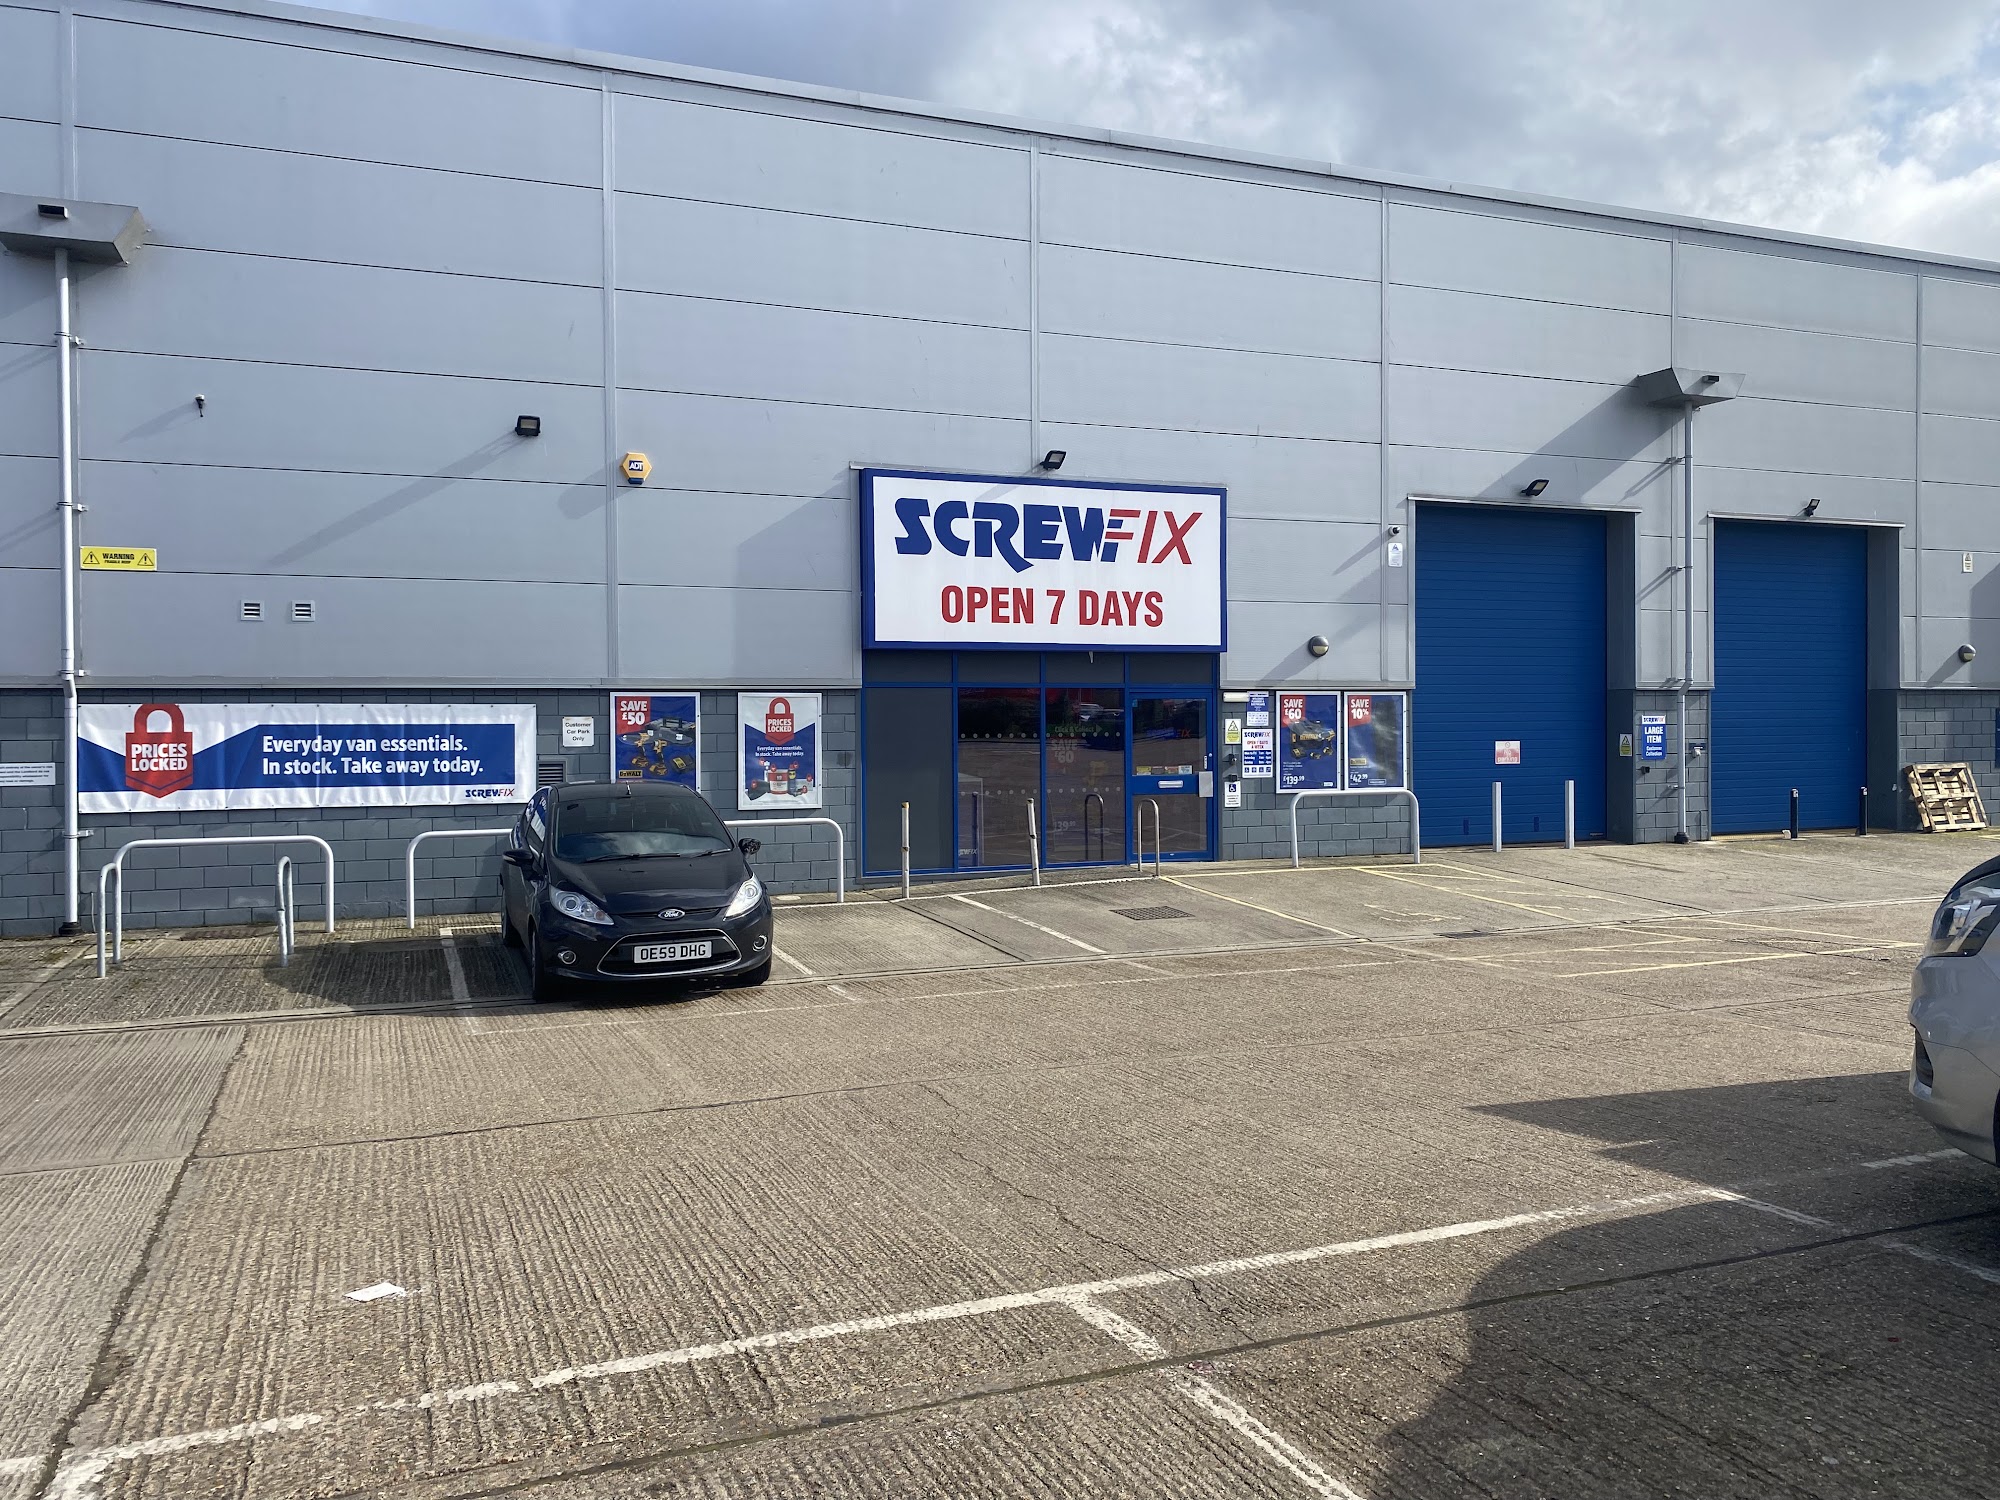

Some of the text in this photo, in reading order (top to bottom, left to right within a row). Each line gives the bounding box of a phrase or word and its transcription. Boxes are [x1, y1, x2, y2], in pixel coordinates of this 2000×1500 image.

[629, 461, 644, 471] ADT
[894, 497, 1203, 573] SCREWFIX
[941, 585, 1164, 627] OPEN 7 DAYS
[620, 700, 648, 711] SAVE
[1283, 698, 1304, 708] SAVE
[1350, 698, 1370, 708] SAVE
[622, 711, 646, 725] £50
[1284, 708, 1302, 720] £60
[1351, 708, 1369, 719] 10%
[767, 718, 792, 726] PRICES
[767, 725, 792, 733] LOCKED
[1644, 726, 1664, 735] LARGE
[263, 734, 468, 755] Everyday van essentials.
[1051, 739, 1078, 750] SAVE
[1646, 735, 1662, 743] ITEM
[131, 743, 188, 758] PRICES
[1055, 750, 1075, 764] £60
[131, 758, 188, 772] LOCKED
[263, 756, 484, 777] In stock. Take away today.
[465, 788, 515, 798] SCREWFIX
[640, 944, 706, 961] OE59 DHG
